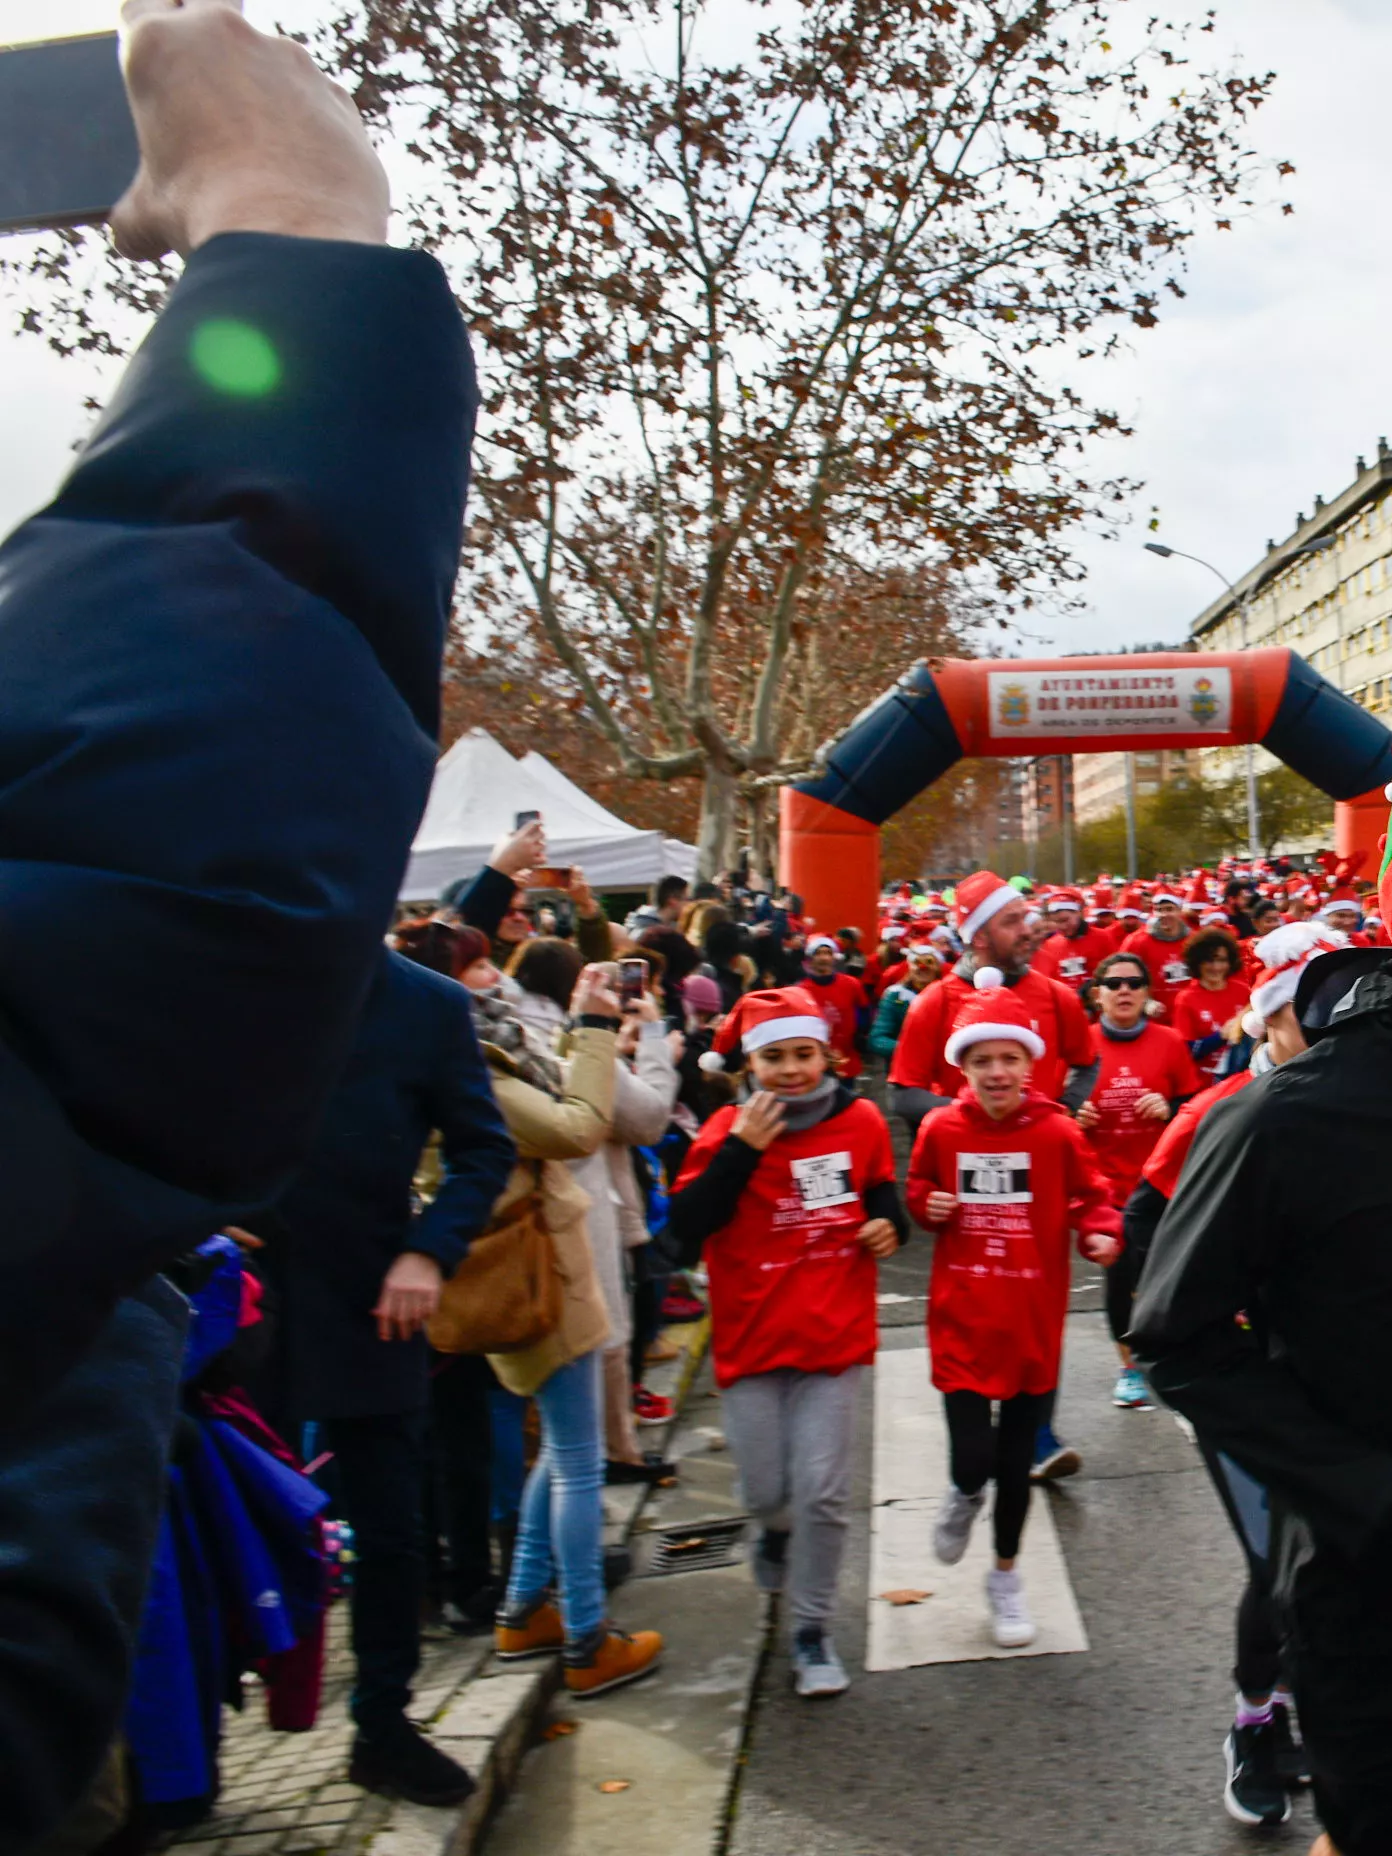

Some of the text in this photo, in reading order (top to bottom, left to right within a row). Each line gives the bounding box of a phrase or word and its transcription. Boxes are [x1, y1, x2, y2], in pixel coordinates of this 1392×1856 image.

[1040, 676, 1175, 691] AYUNTAMIENTO
[1037, 695, 1179, 711] DE PONFERRADA
